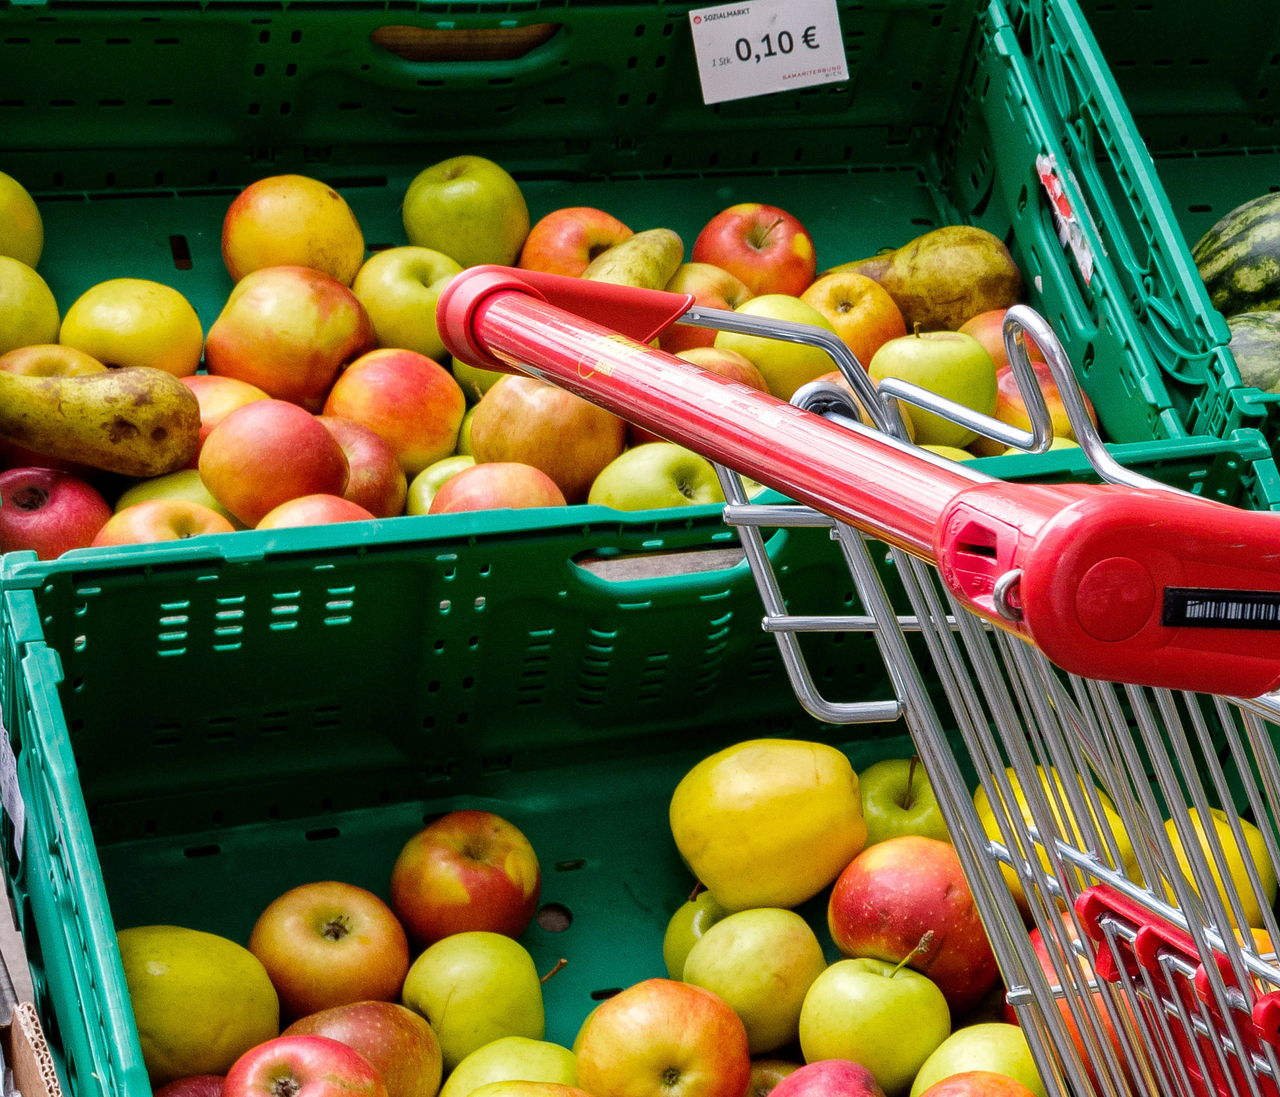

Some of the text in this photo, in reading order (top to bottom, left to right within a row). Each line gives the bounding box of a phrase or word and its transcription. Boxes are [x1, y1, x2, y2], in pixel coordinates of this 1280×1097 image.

[703, 7, 750, 22] SOZIALMARKT
[711, 25, 820, 68] 1 Stk. 0,10 €
[782, 65, 842, 80] SAMARITERBUND
